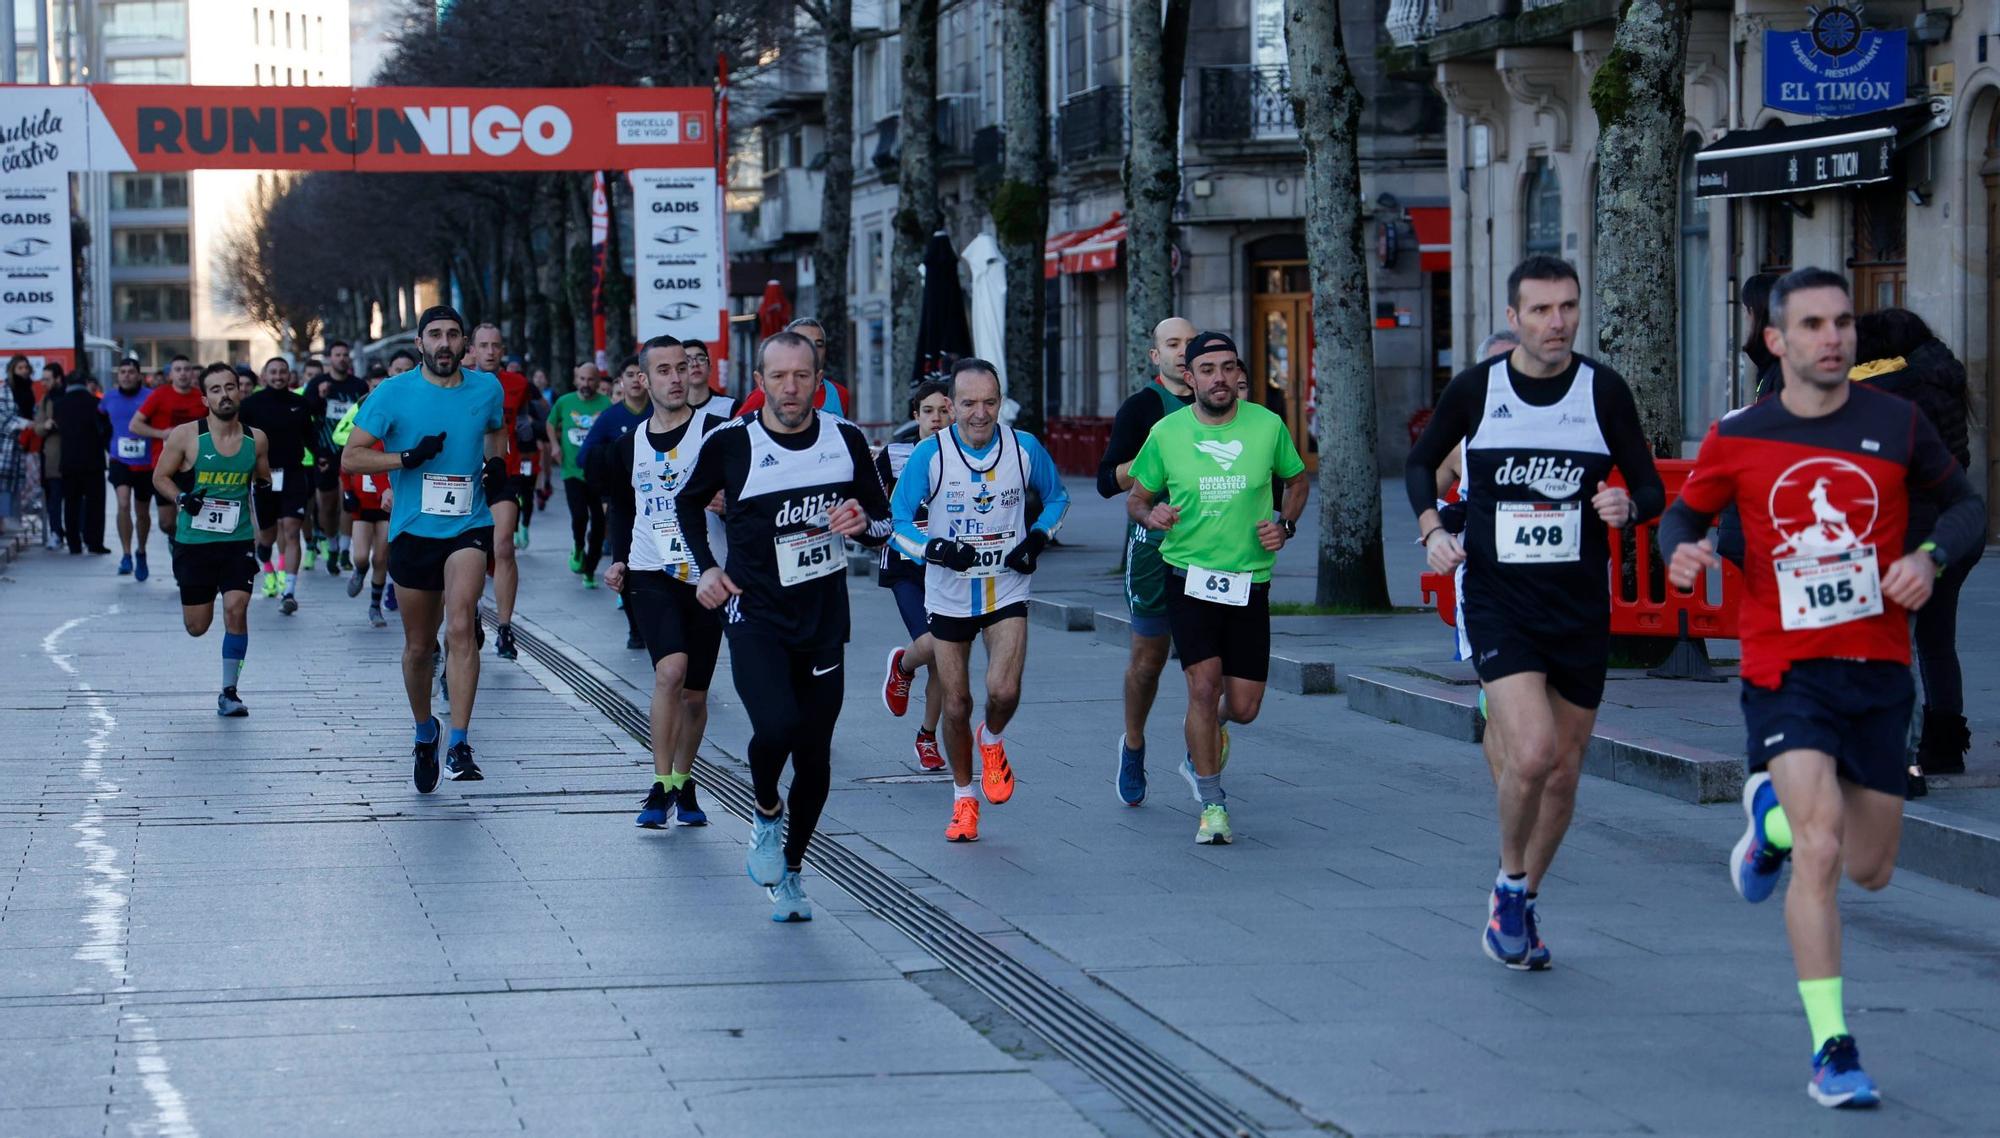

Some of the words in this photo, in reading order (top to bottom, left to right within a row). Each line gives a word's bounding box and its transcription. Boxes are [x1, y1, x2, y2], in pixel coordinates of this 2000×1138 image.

[1790, 37, 1818, 74] TAPERIA
[1824, 36, 1883, 78] RESTAURANTE
[1781, 82, 1810, 101] EL
[1815, 77, 1891, 101] TIMÓN
[621, 119, 674, 127] CONCELLO
[645, 128, 668, 136] VIGO
[2, 141, 59, 174] castro
[1816, 156, 1828, 180] EL
[652, 201, 699, 213] GADIS
[1, 212, 52, 225] GADIS
[653, 278, 702, 290] GADIS
[3, 291, 54, 303] GADIS
[1495, 456, 1585, 486] delikia
[1200, 476, 1225, 484] VIANA
[1226, 474, 1246, 483] 2023
[1200, 483, 1211, 491] DO
[1212, 482, 1247, 490] CASTELO
[444, 491, 455, 505] 4
[209, 511, 223, 524] 31
[1515, 525, 1563, 546] 498
[797, 544, 831, 568] 451
[972, 550, 1003, 567] 207
[1205, 575, 1230, 593] 63
[1805, 579, 1854, 608] 185
